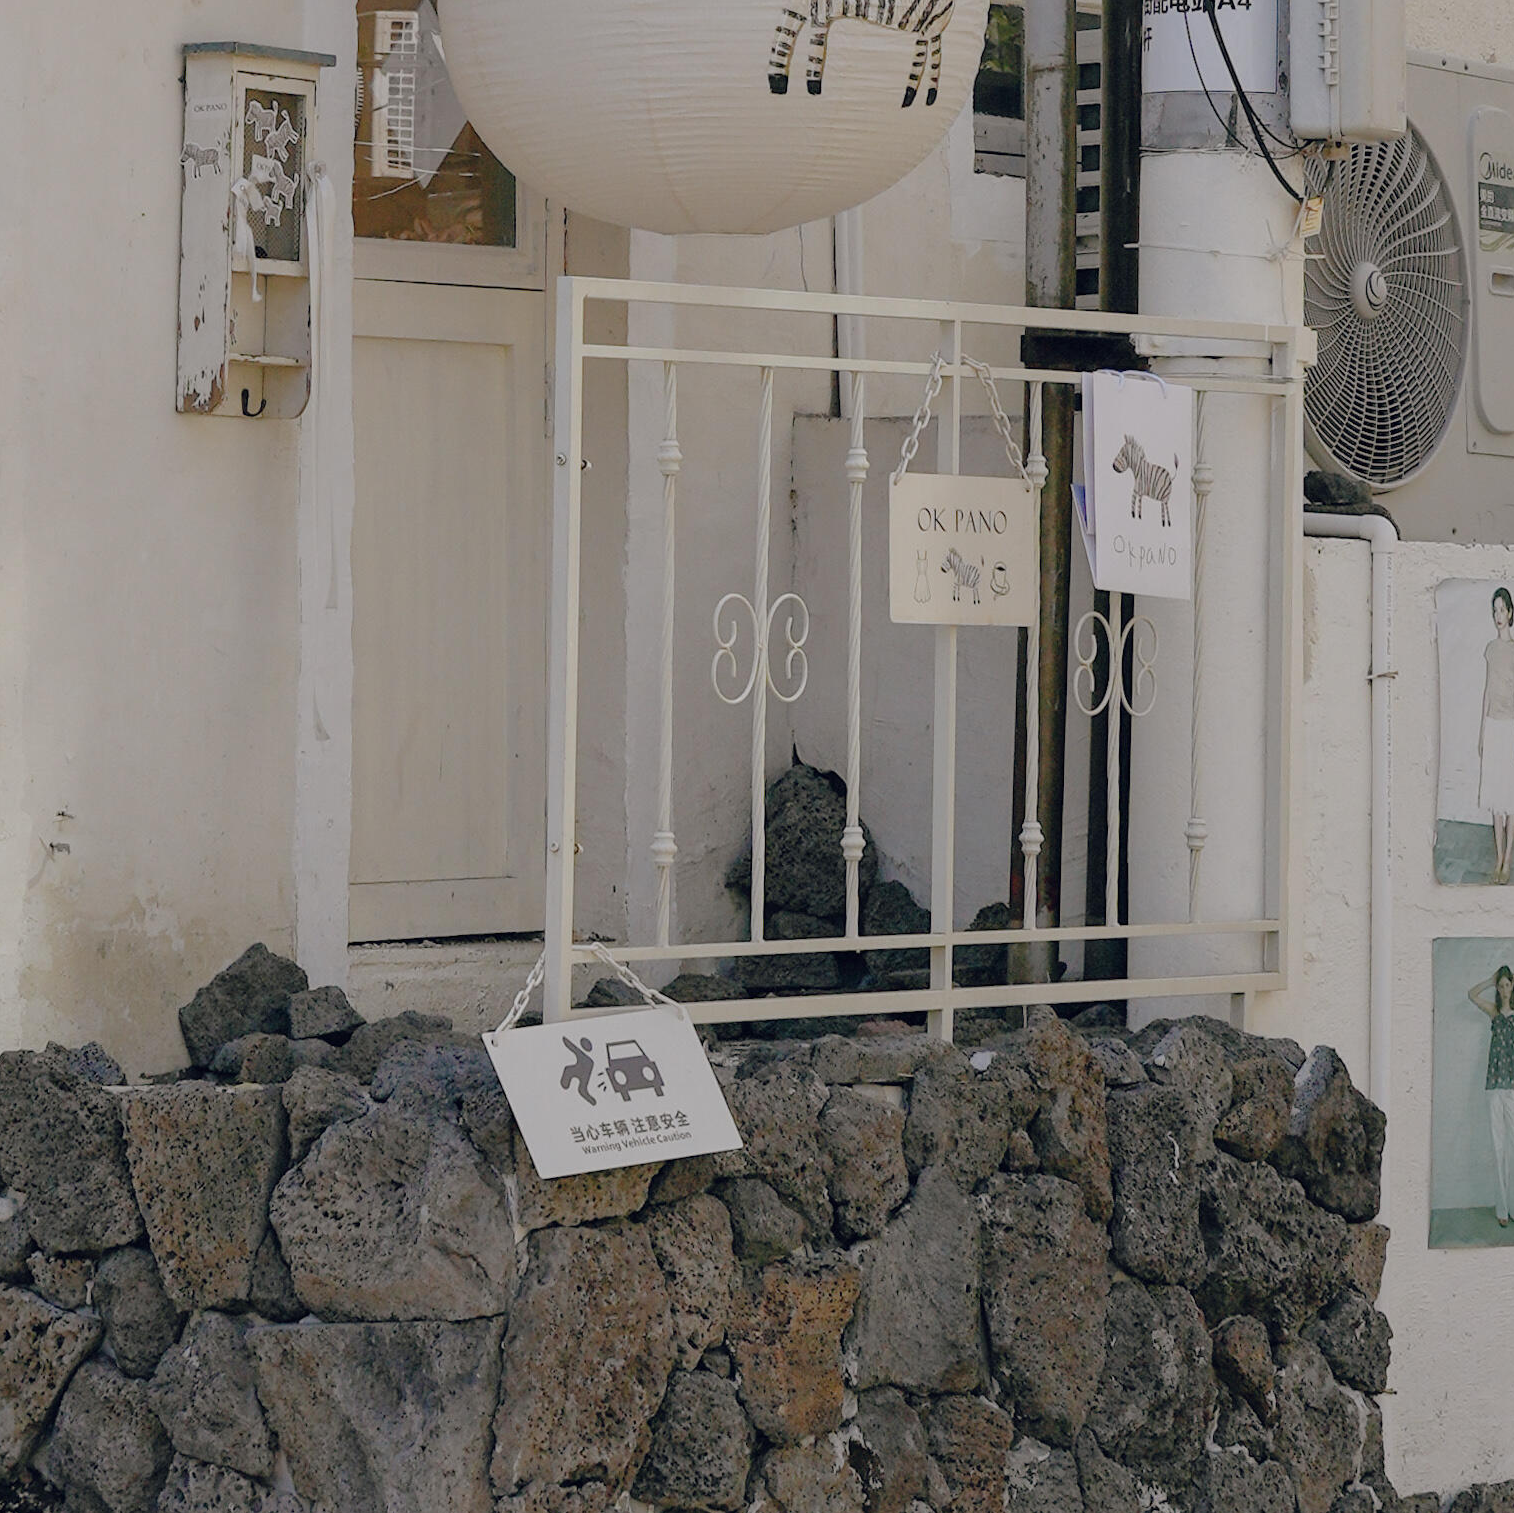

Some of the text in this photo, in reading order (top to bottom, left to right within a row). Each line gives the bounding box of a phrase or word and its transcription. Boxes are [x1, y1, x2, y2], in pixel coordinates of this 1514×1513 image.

[917, 507, 1008, 535] OK PANO
[570, 1110, 690, 1143] 当心车辆 注意安全
[581, 1131, 692, 1155] Warning Vehicle Caution
